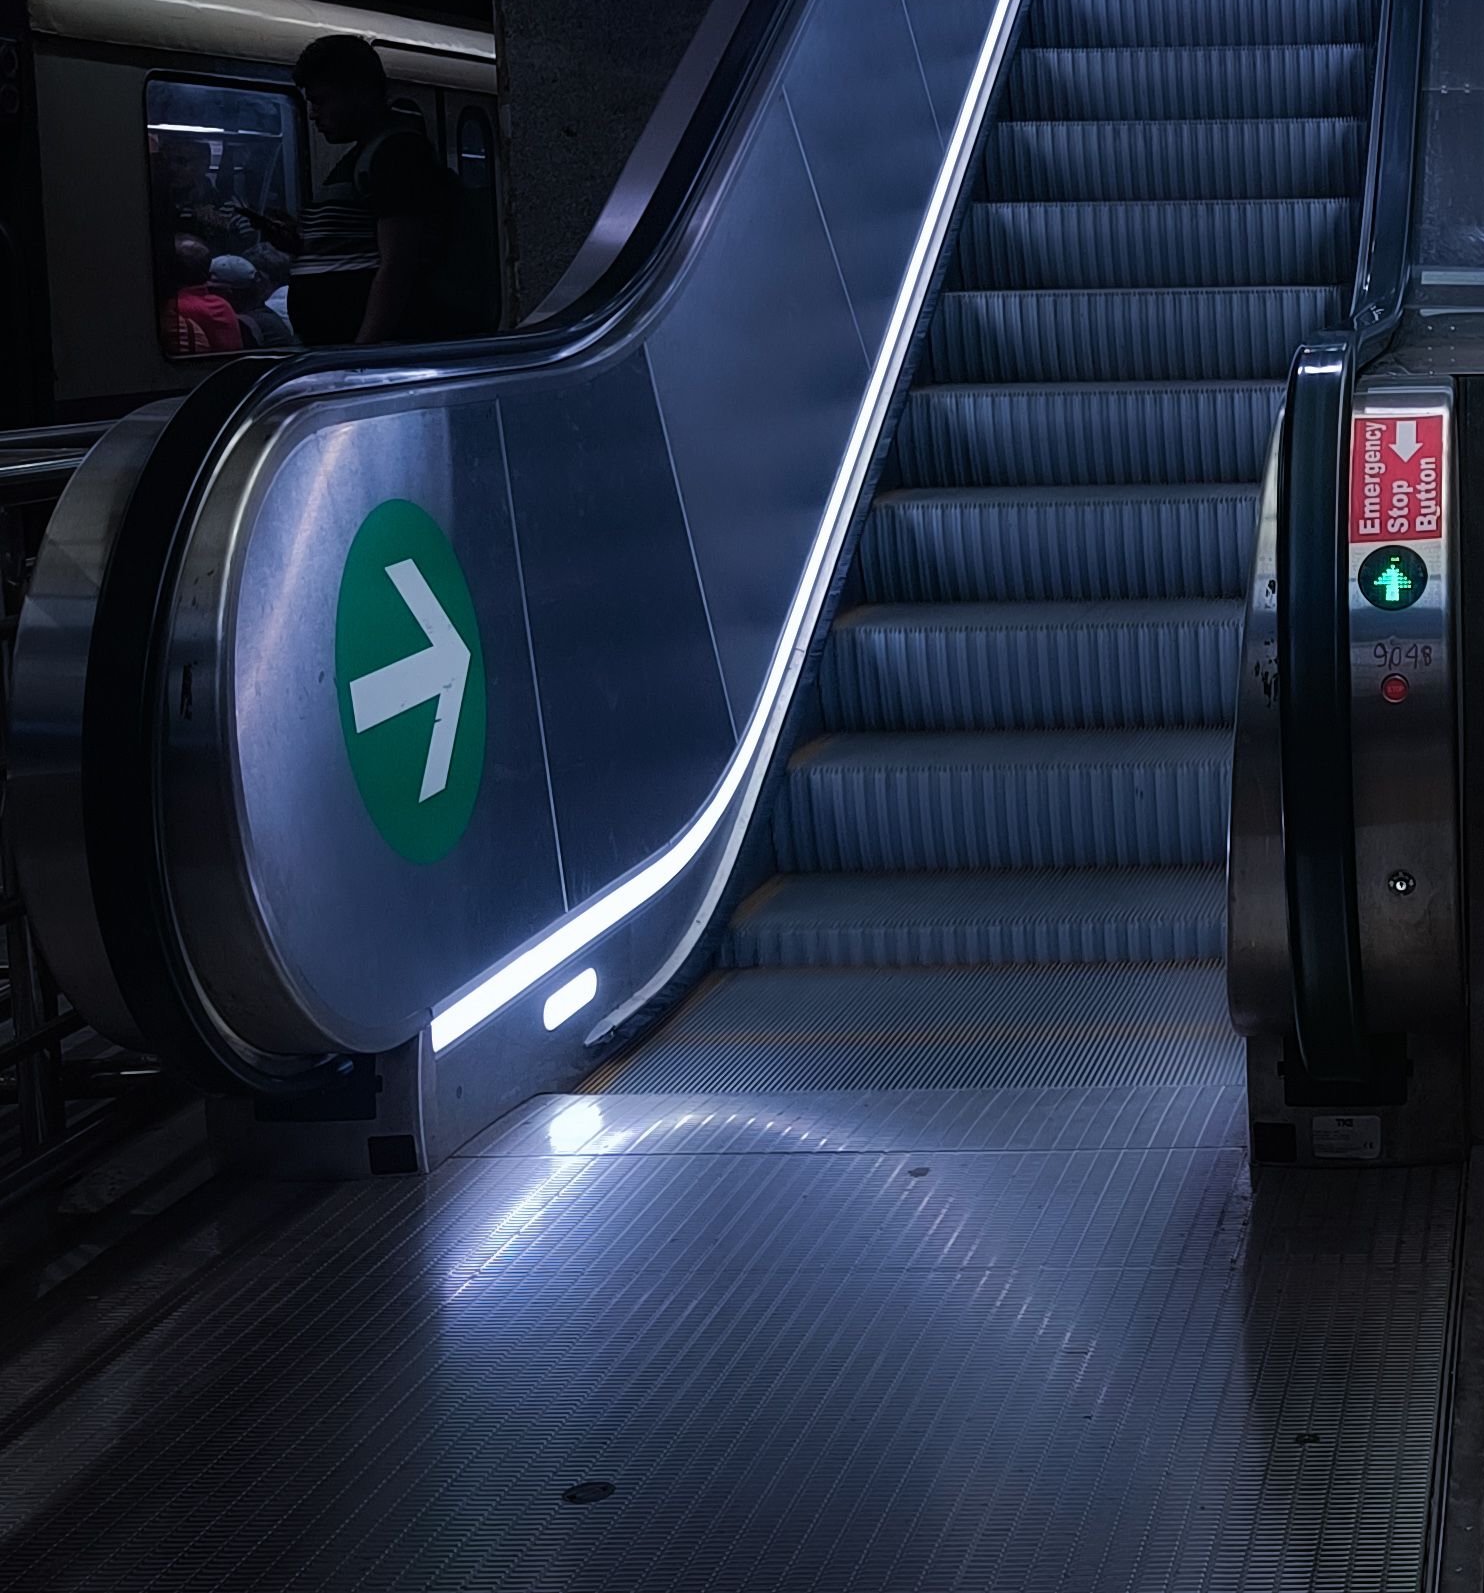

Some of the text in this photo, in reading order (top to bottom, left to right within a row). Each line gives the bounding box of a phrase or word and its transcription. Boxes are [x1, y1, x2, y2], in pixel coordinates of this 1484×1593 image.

[1359, 422, 1386, 534] Emergency
[1387, 480, 1413, 533] Stop
[1416, 457, 1440, 532] Button
